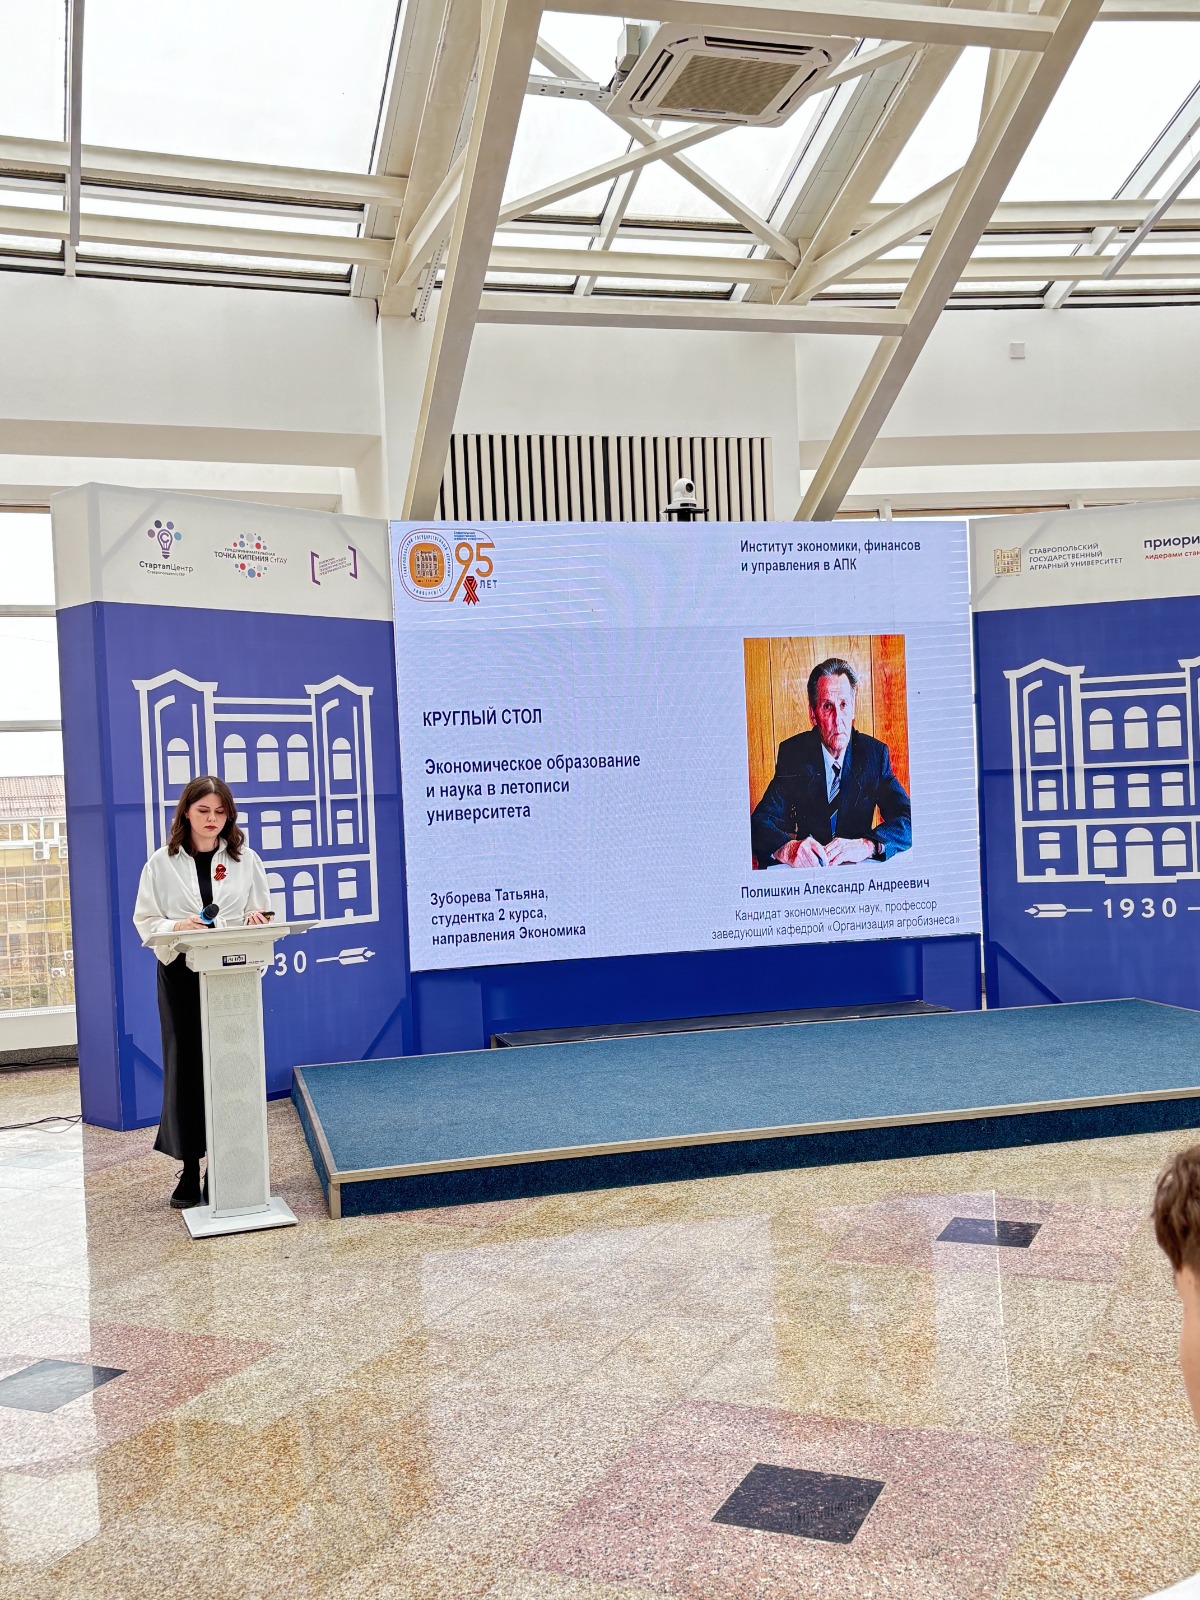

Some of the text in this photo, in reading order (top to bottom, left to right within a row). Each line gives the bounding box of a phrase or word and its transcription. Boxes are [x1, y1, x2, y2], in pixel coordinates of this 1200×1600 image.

[740, 539, 921, 555] Институт экономики, финансов
[1029, 543, 1098, 554] СТАВРОПОЛЬСКИЙ
[1144, 536, 1200, 550] приори
[214, 551, 236, 559] ТОЧКА
[238, 554, 268, 562] КИПЕНИЯ
[741, 558, 857, 574] и управления в АПК
[1029, 550, 1103, 563] ГОСУДАРСТВЕННЫЙ
[1029, 557, 1123, 571] АГРАРНЫЙ УНИВЕРСИТЕТ
[1145, 552, 1182, 560] лидерами
[139, 560, 194, 573] СтартапЦентр
[449, 542, 495, 602] 95
[479, 580, 497, 589] ЛЕТ
[423, 706, 542, 726] КРУГЛЫЙ СТОЛ
[425, 754, 641, 775] Экономическое образование
[426, 780, 570, 800] и наука в летописи
[427, 805, 531, 826] университета
[430, 888, 548, 908] Зуборева Татьяна,
[741, 878, 930, 898] Полишкин Александр Андреевич
[431, 908, 547, 928] студентка 2 курса,
[735, 899, 938, 922] Кандидат экономических наук, профессор
[1103, 897, 1177, 919] 1930
[432, 925, 586, 947] направления Экономика
[711, 915, 960, 941] заведующий кафедрой «Организация агробизнеса»
[261, 950, 307, 978] 30
